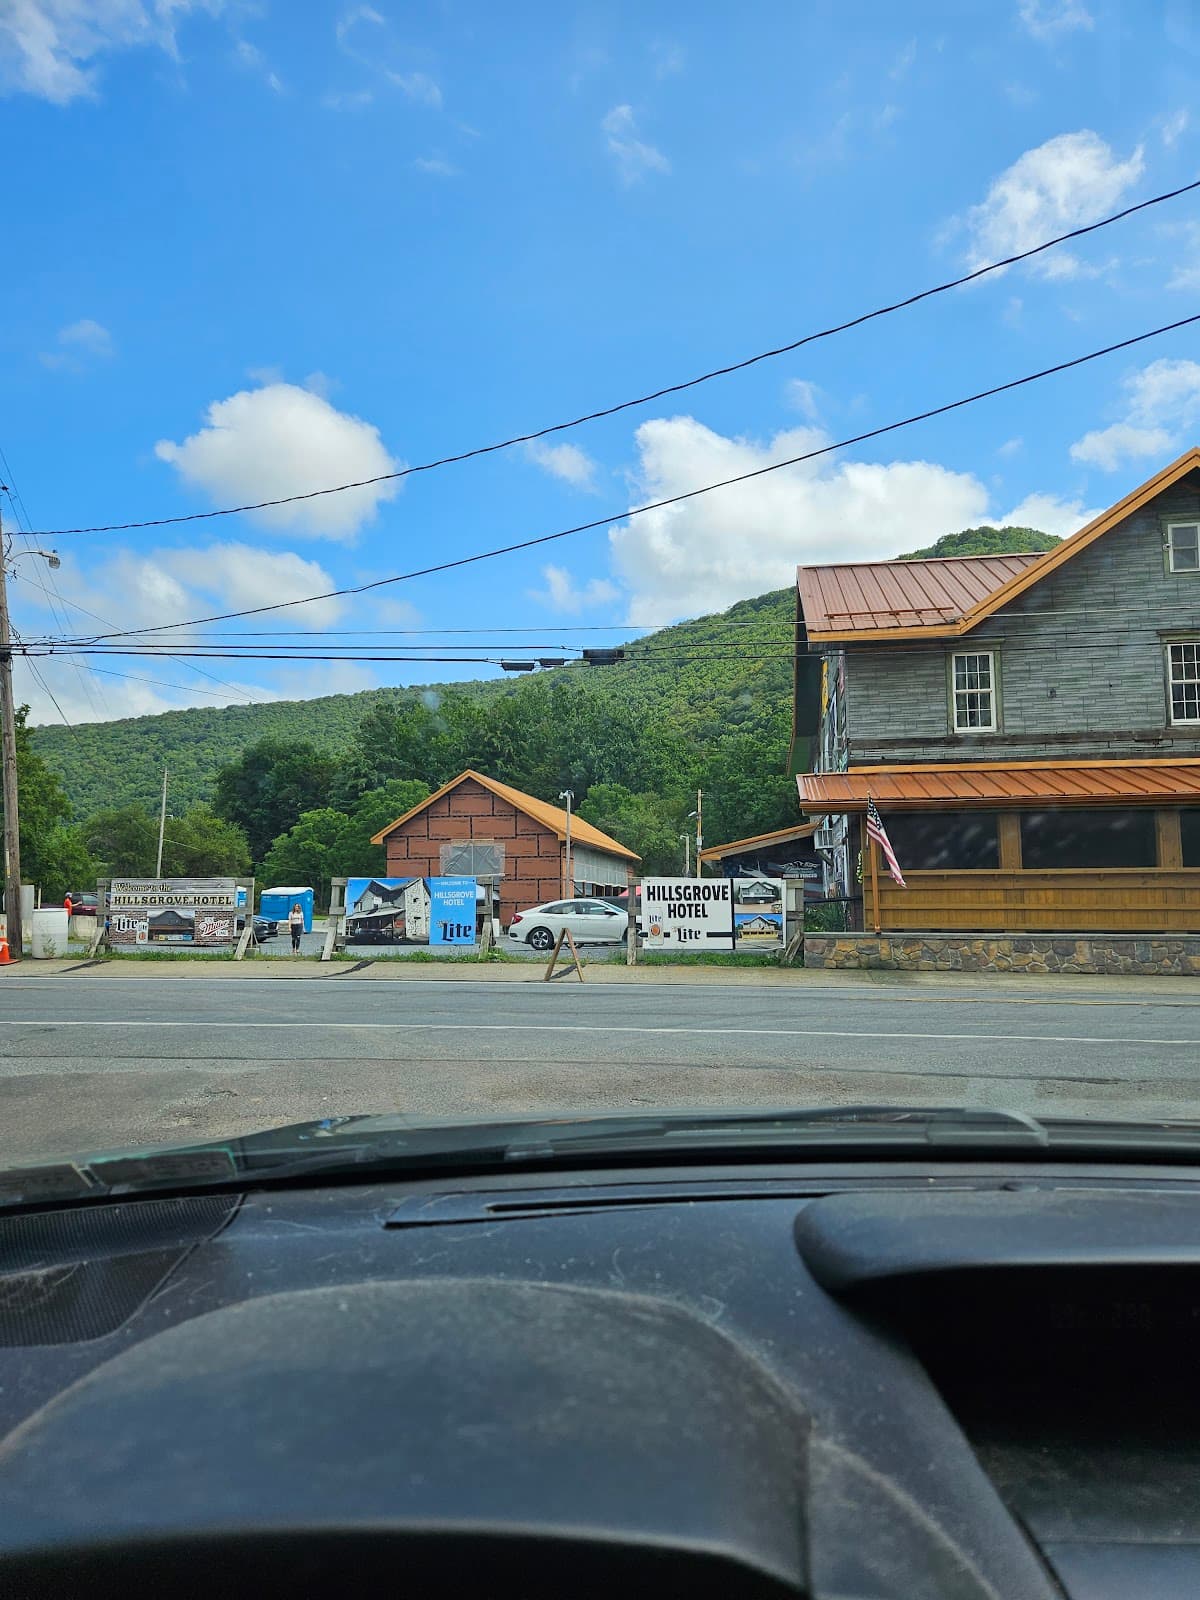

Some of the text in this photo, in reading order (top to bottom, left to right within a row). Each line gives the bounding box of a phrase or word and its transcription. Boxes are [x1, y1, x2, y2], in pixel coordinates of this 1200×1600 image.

[115, 883, 148, 893] Welcome
[160, 882, 171, 893] the
[646, 885, 729, 901] HILLSGROVE
[114, 896, 232, 905] HILLSGROVE HOTEL
[434, 891, 475, 899] HILLSGROVE
[667, 903, 709, 918] HOTEL
[117, 918, 138, 932] Lite
[442, 922, 472, 942] Lite
[677, 927, 701, 943] Lite
